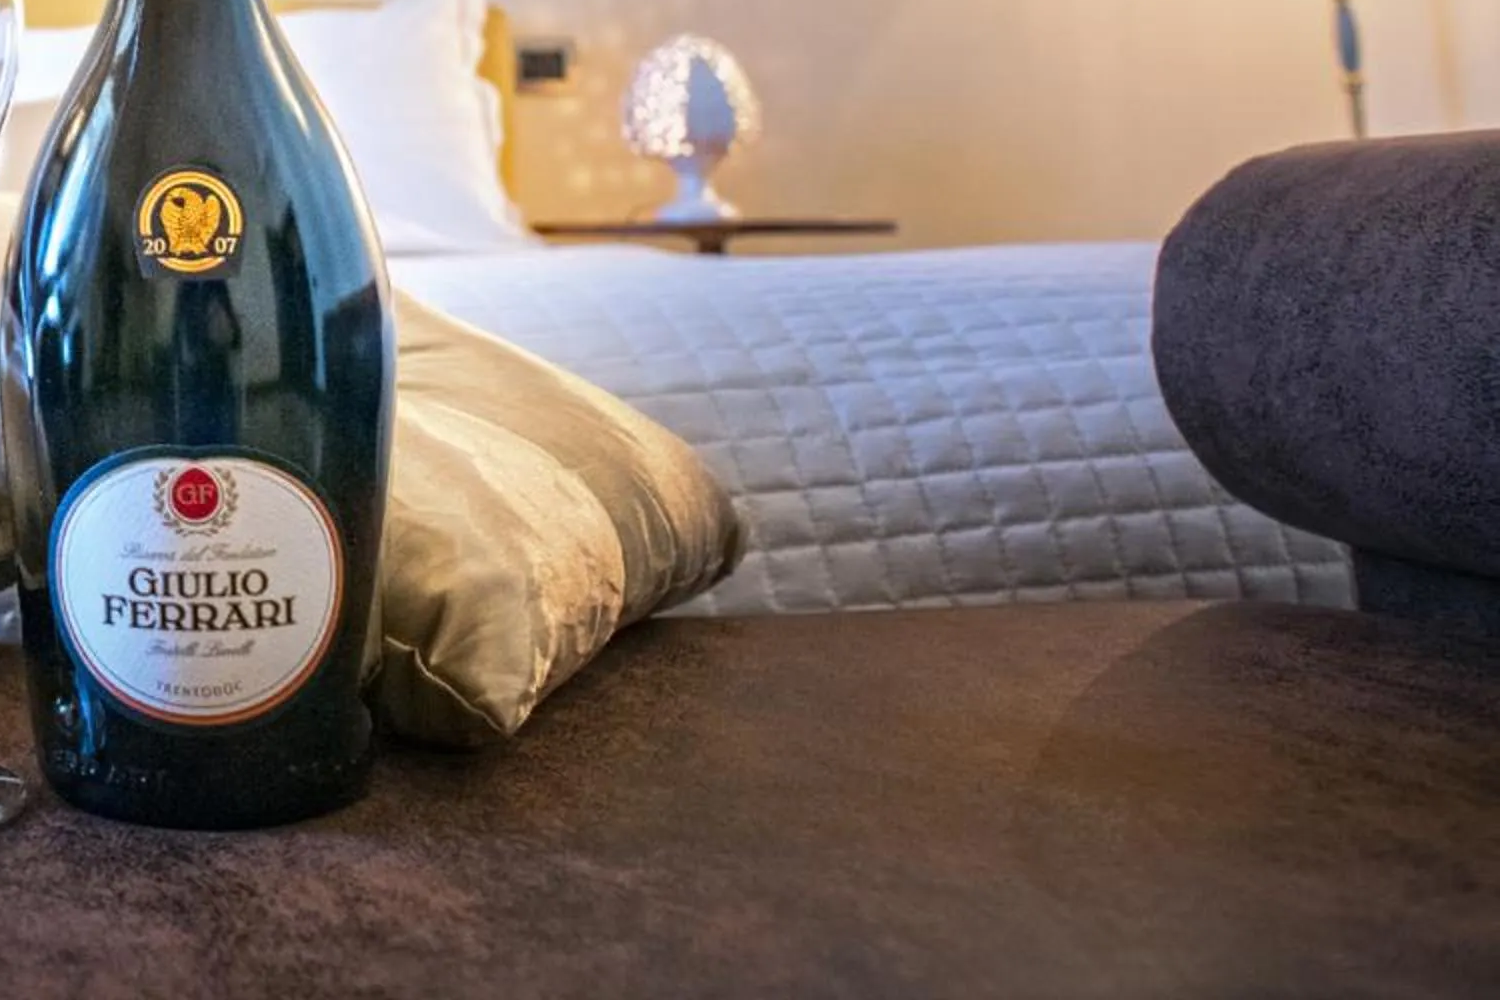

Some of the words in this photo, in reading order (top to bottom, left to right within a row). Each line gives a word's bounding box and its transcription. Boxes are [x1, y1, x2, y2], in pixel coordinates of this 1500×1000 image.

[176, 483, 215, 505] GF
[128, 567, 269, 599] GIULIO
[102, 594, 296, 632] FERRARI
